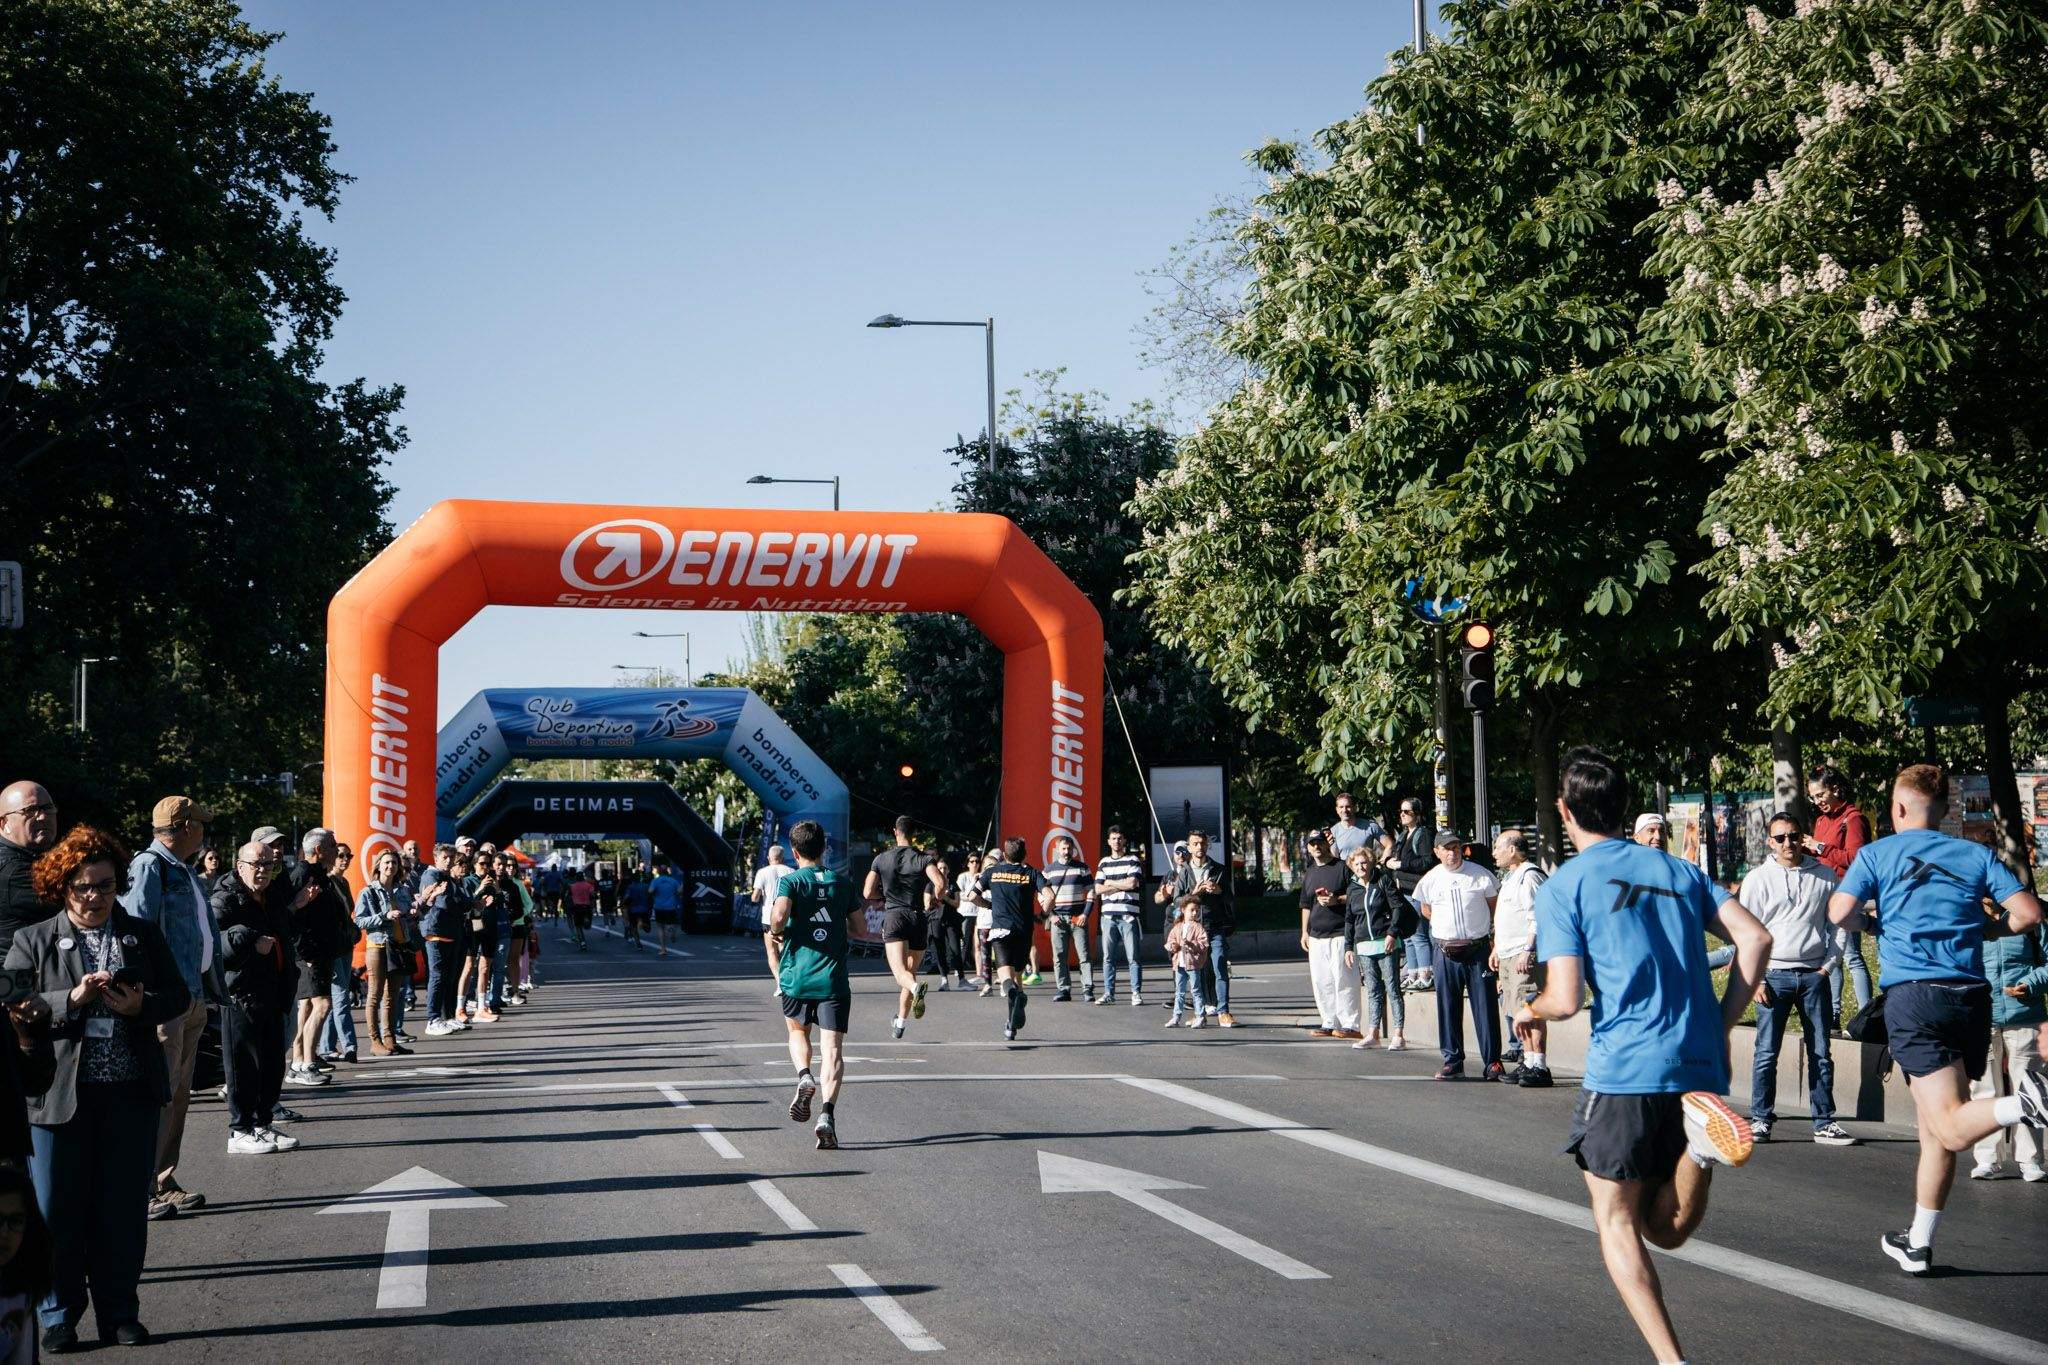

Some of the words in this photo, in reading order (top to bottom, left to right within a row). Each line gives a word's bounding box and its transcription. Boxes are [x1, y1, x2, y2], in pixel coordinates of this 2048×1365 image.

[668, 530, 918, 588] ENERVIT
[554, 593, 696, 609] Science
[705, 596, 739, 610] in
[750, 597, 908, 612] Nutrition
[527, 698, 573, 714] Club
[537, 712, 633, 738] Deportivo
[369, 672, 409, 838] ENERVIT
[436, 722, 488, 784] mberos
[737, 743, 796, 802] madrid
[751, 727, 821, 802] bomberos
[1050, 679, 1085, 833] ENERVIT
[533, 797, 634, 812] DECIMAS
